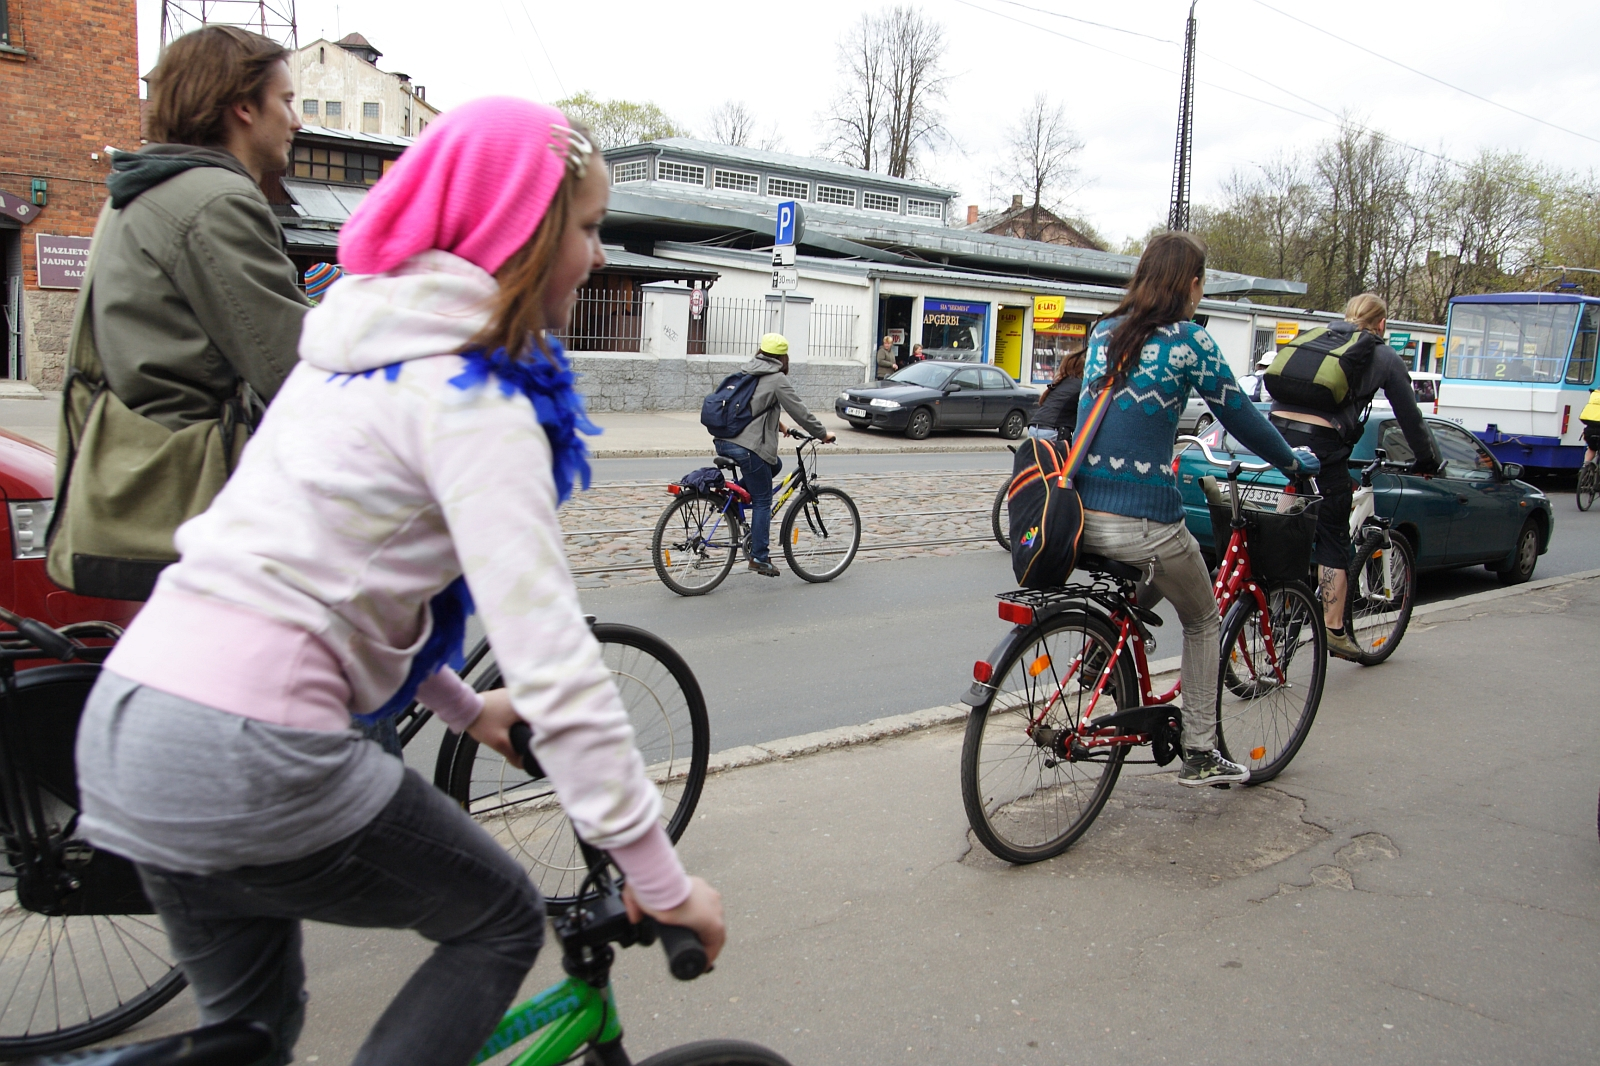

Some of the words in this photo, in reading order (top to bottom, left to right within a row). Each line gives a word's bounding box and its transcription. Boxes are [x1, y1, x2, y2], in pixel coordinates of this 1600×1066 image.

[779, 207, 791, 240] P
[43, 246, 90, 255] MAZLIETO
[41, 257, 75, 266] JAUNU
[778, 275, 785, 284] 30
[1495, 363, 1506, 377] 2
